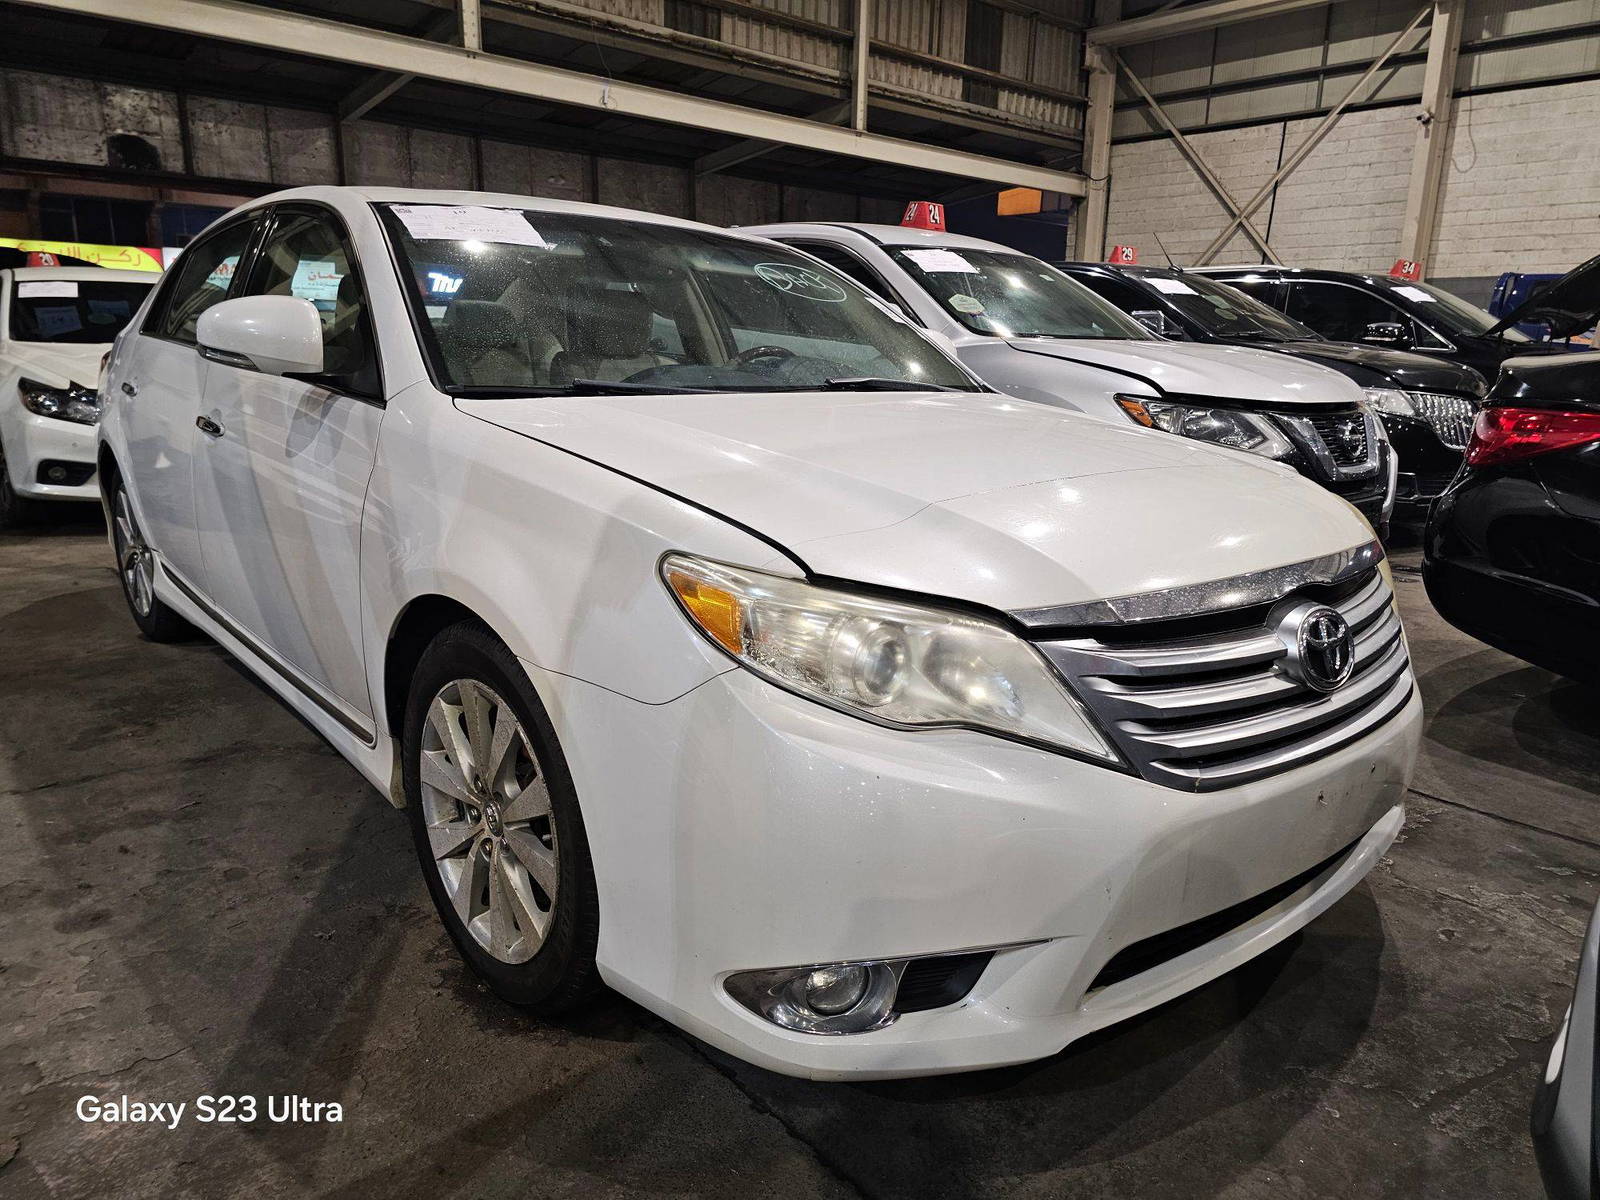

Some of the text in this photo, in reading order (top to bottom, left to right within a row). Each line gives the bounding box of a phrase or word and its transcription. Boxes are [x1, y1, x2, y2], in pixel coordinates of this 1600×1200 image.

[929, 204, 940, 224] 24
[1122, 247, 1133, 261] 29
[1402, 261, 1416, 274] 34
